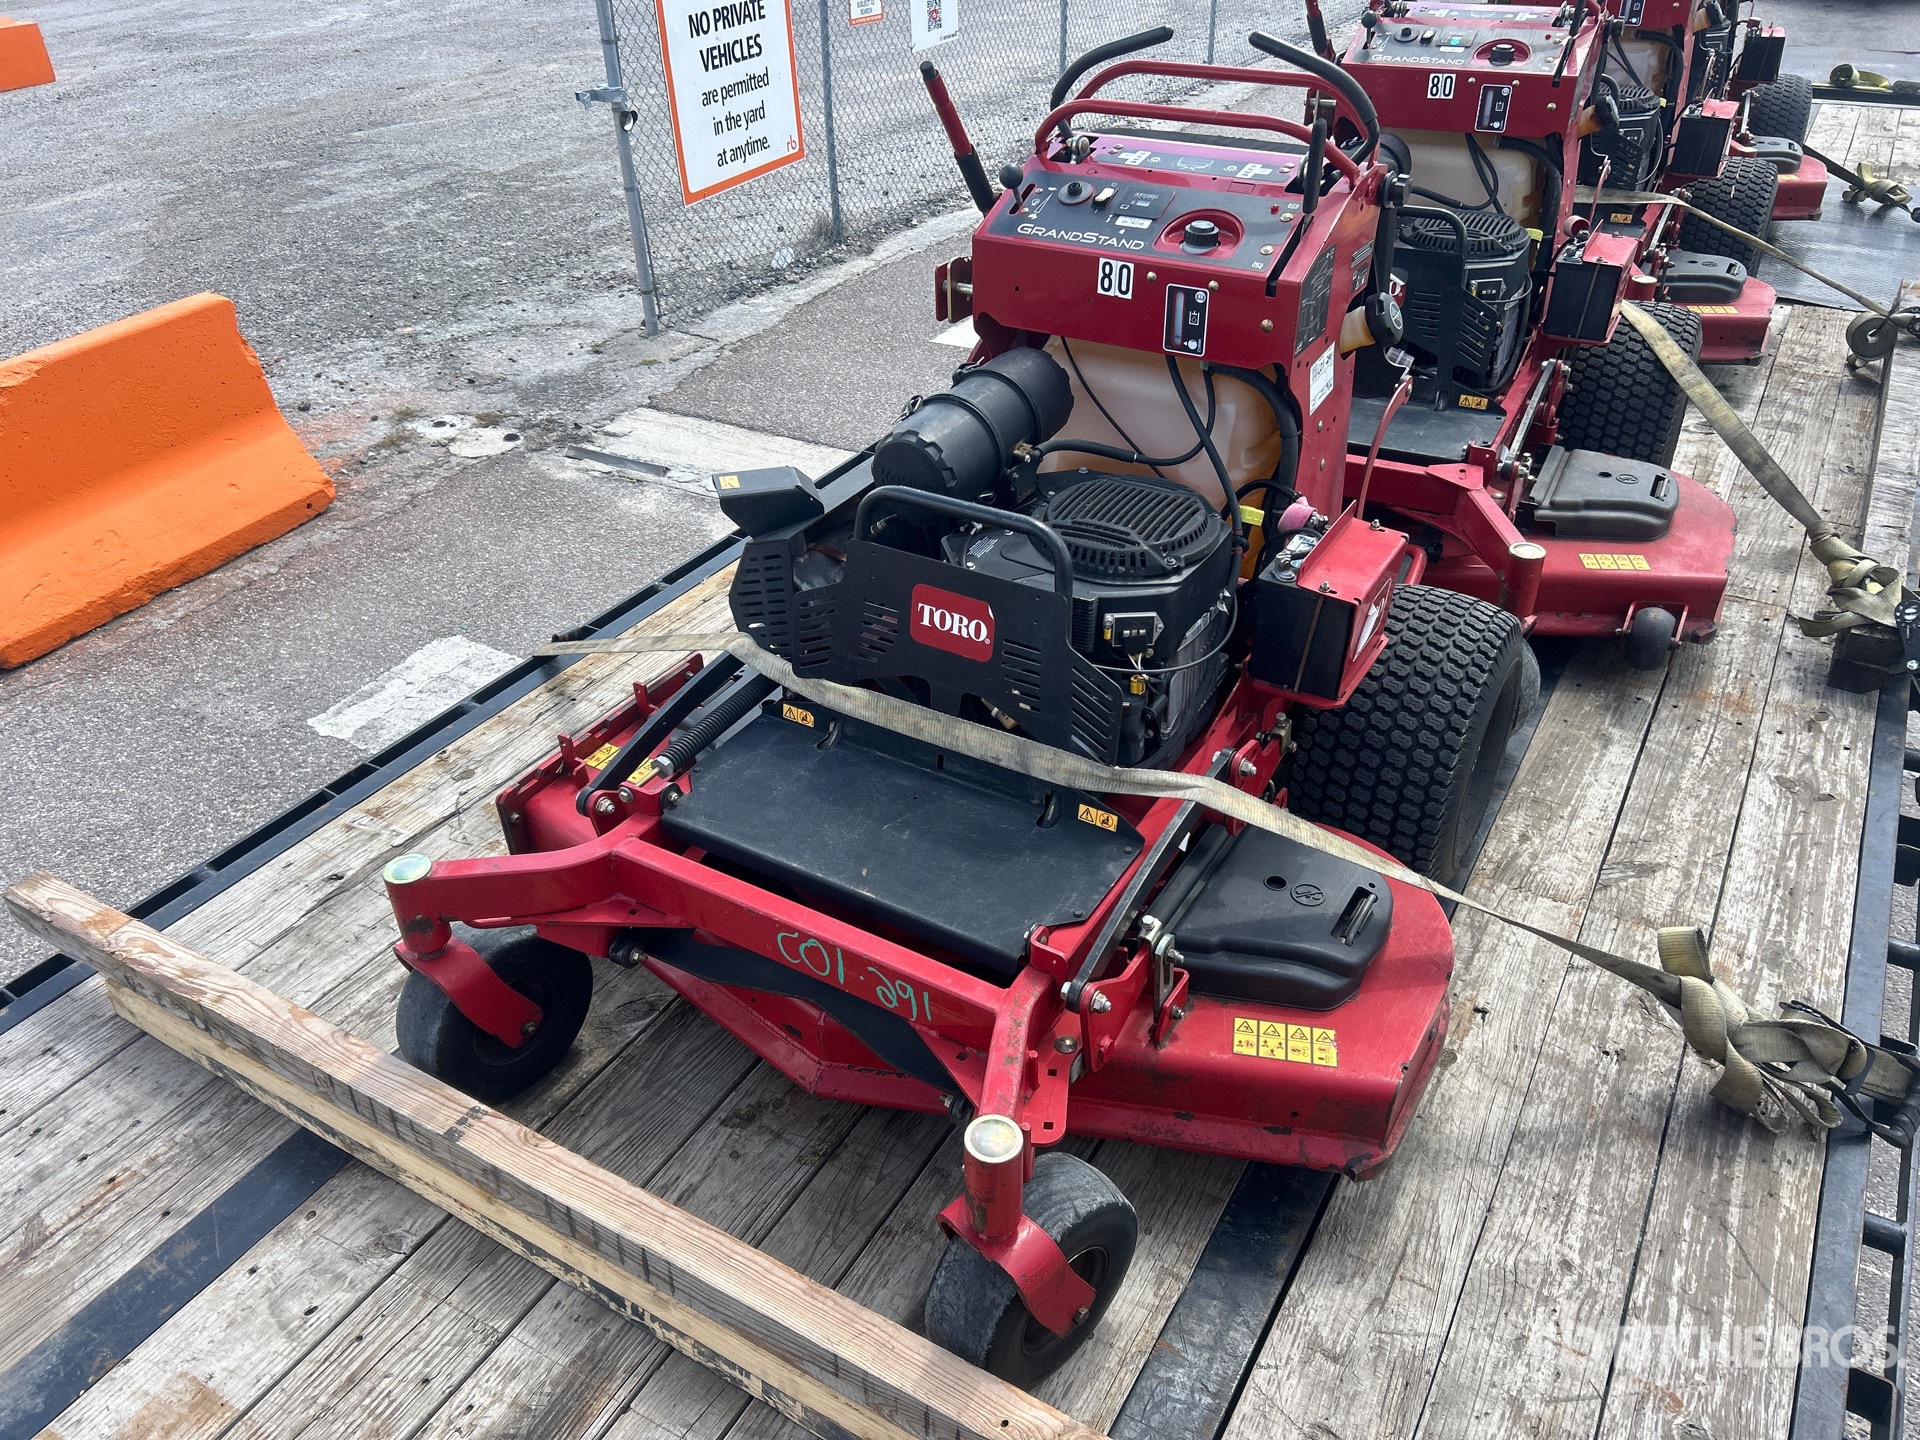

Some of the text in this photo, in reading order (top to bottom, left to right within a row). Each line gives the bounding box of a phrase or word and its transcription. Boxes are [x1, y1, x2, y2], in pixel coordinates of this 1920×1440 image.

[688, 0, 766, 39] NO PRIVATE
[699, 33, 763, 72] VEHICLES
[701, 66, 769, 107] are permitted
[1429, 75, 1454, 98] 80
[713, 99, 766, 136] in the yard
[717, 136, 770, 168] at anytime.
[786, 134, 797, 153] rb
[1100, 261, 1132, 296] 80
[917, 602, 988, 642] TORO
